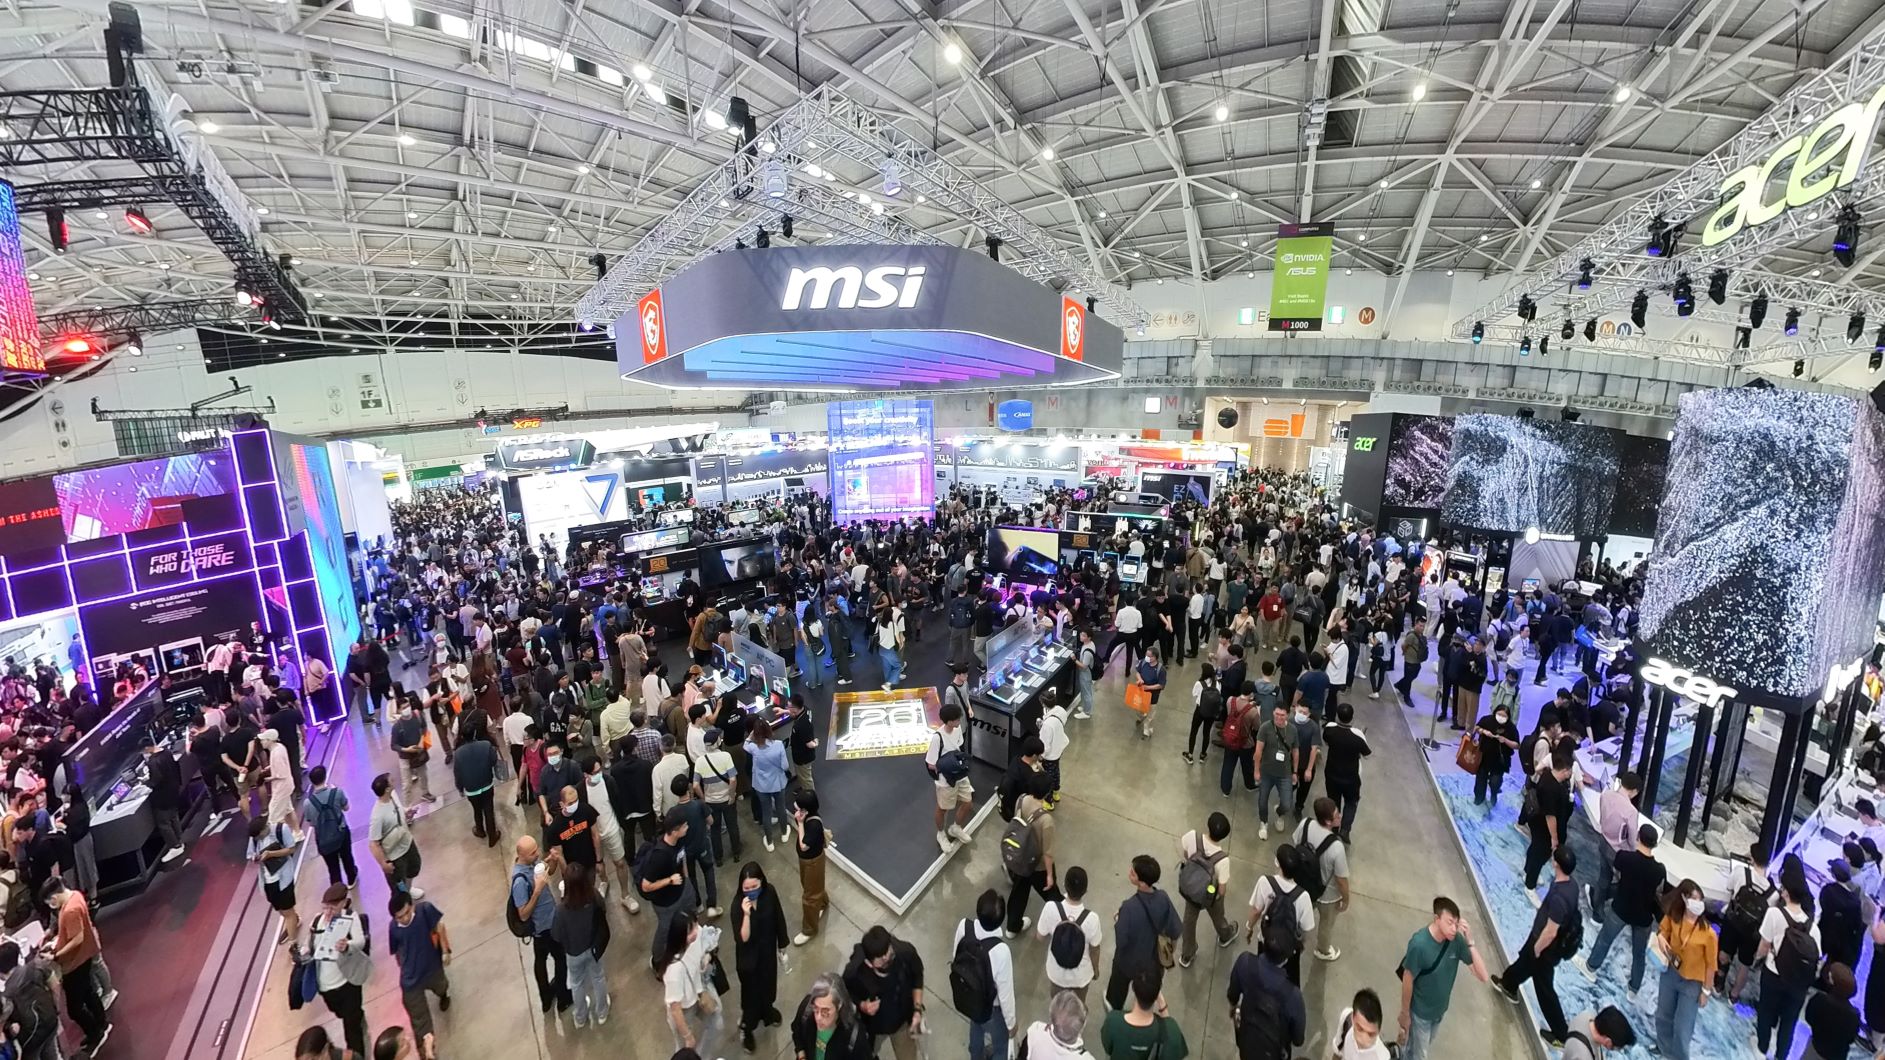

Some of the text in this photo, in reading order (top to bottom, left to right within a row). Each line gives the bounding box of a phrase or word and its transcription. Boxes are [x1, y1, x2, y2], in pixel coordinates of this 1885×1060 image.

[1702, 84, 1885, 247] acer
[1294, 253, 1325, 262] NVIDIA
[1286, 267, 1317, 276] ASUS
[781, 266, 927, 311] msi
[512, 420, 541, 430] XPG
[1354, 437, 1377, 452] acer
[1173, 484, 1186, 493] EZ
[8, 513, 27, 524] THE
[149, 551, 235, 575] WHO DARE
[150, 543, 224, 566] FOR THOSE
[1641, 657, 1738, 708] acer
[970, 717, 1008, 738] msi
